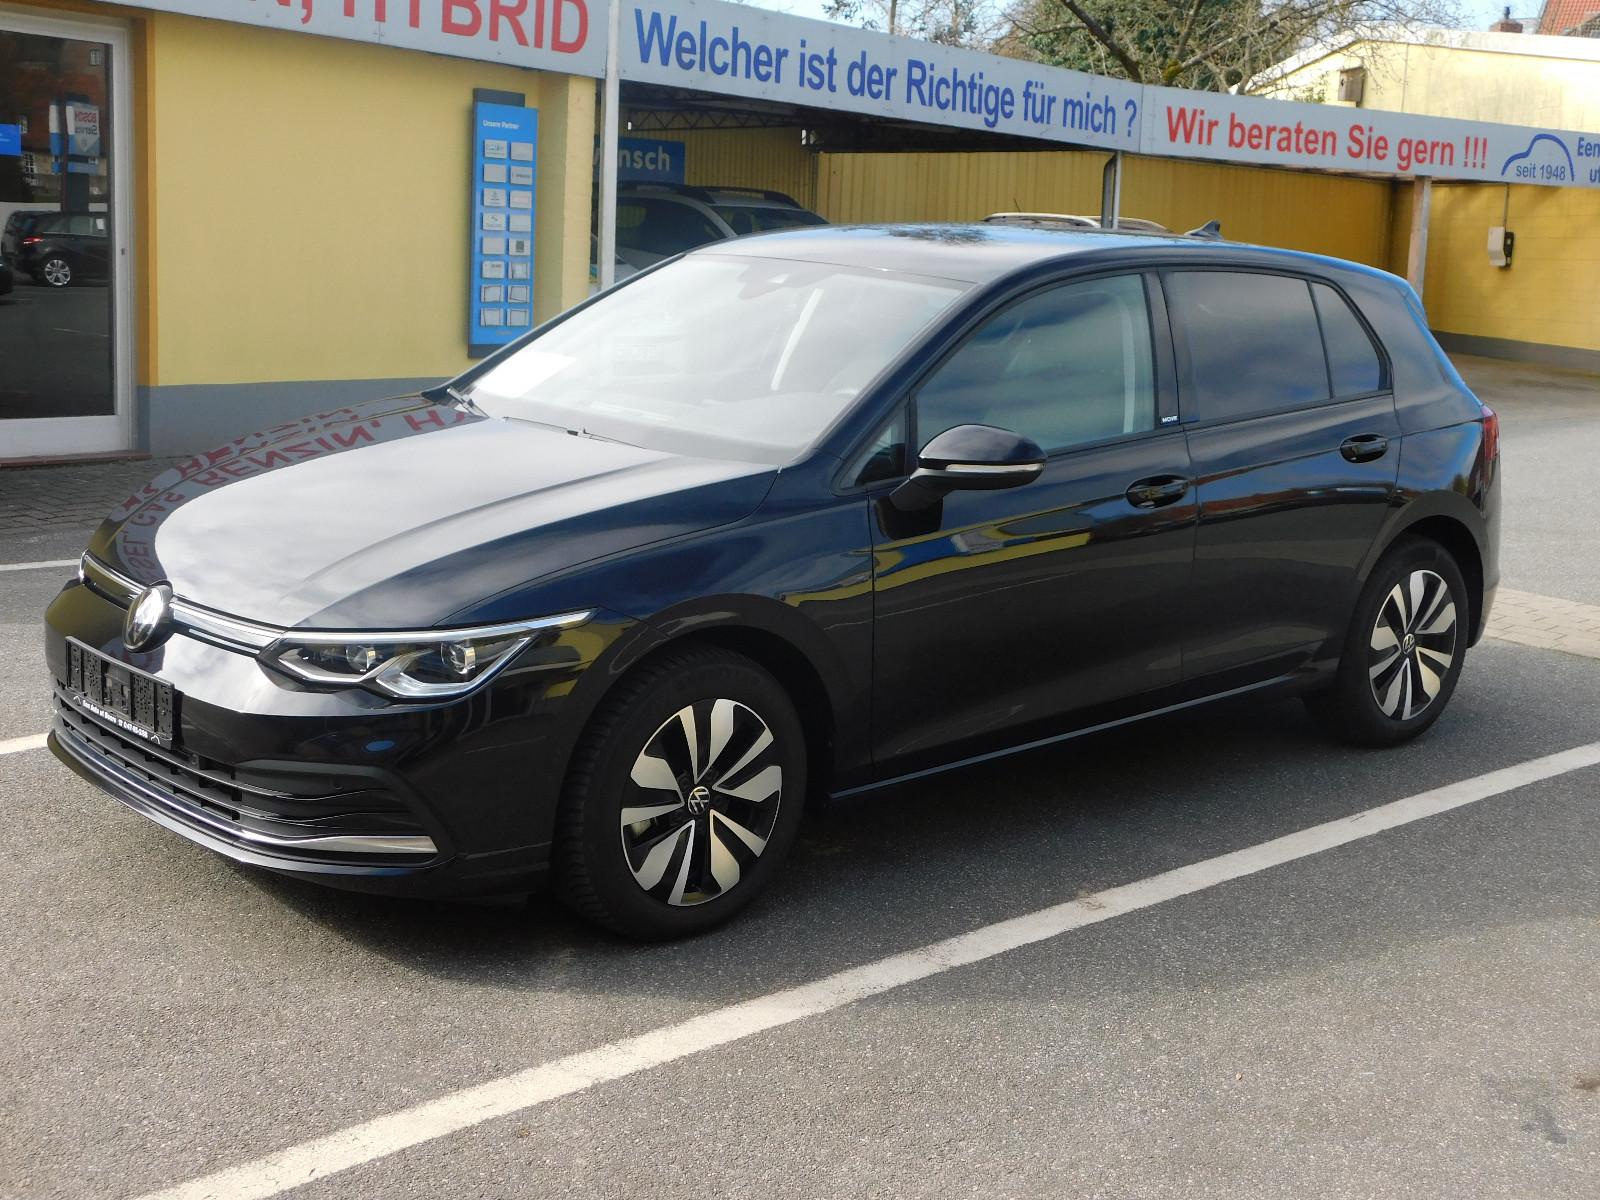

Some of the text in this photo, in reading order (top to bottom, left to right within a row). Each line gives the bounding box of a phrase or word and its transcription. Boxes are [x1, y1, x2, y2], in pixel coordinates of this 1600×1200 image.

[634, 8, 1138, 137] Welcher ist der Richtige für mich ?
[594, 145, 671, 173] nsch
[1166, 105, 1488, 171] Wir beraten Sie gern !!!
[1516, 163, 1566, 181] seit 1948
